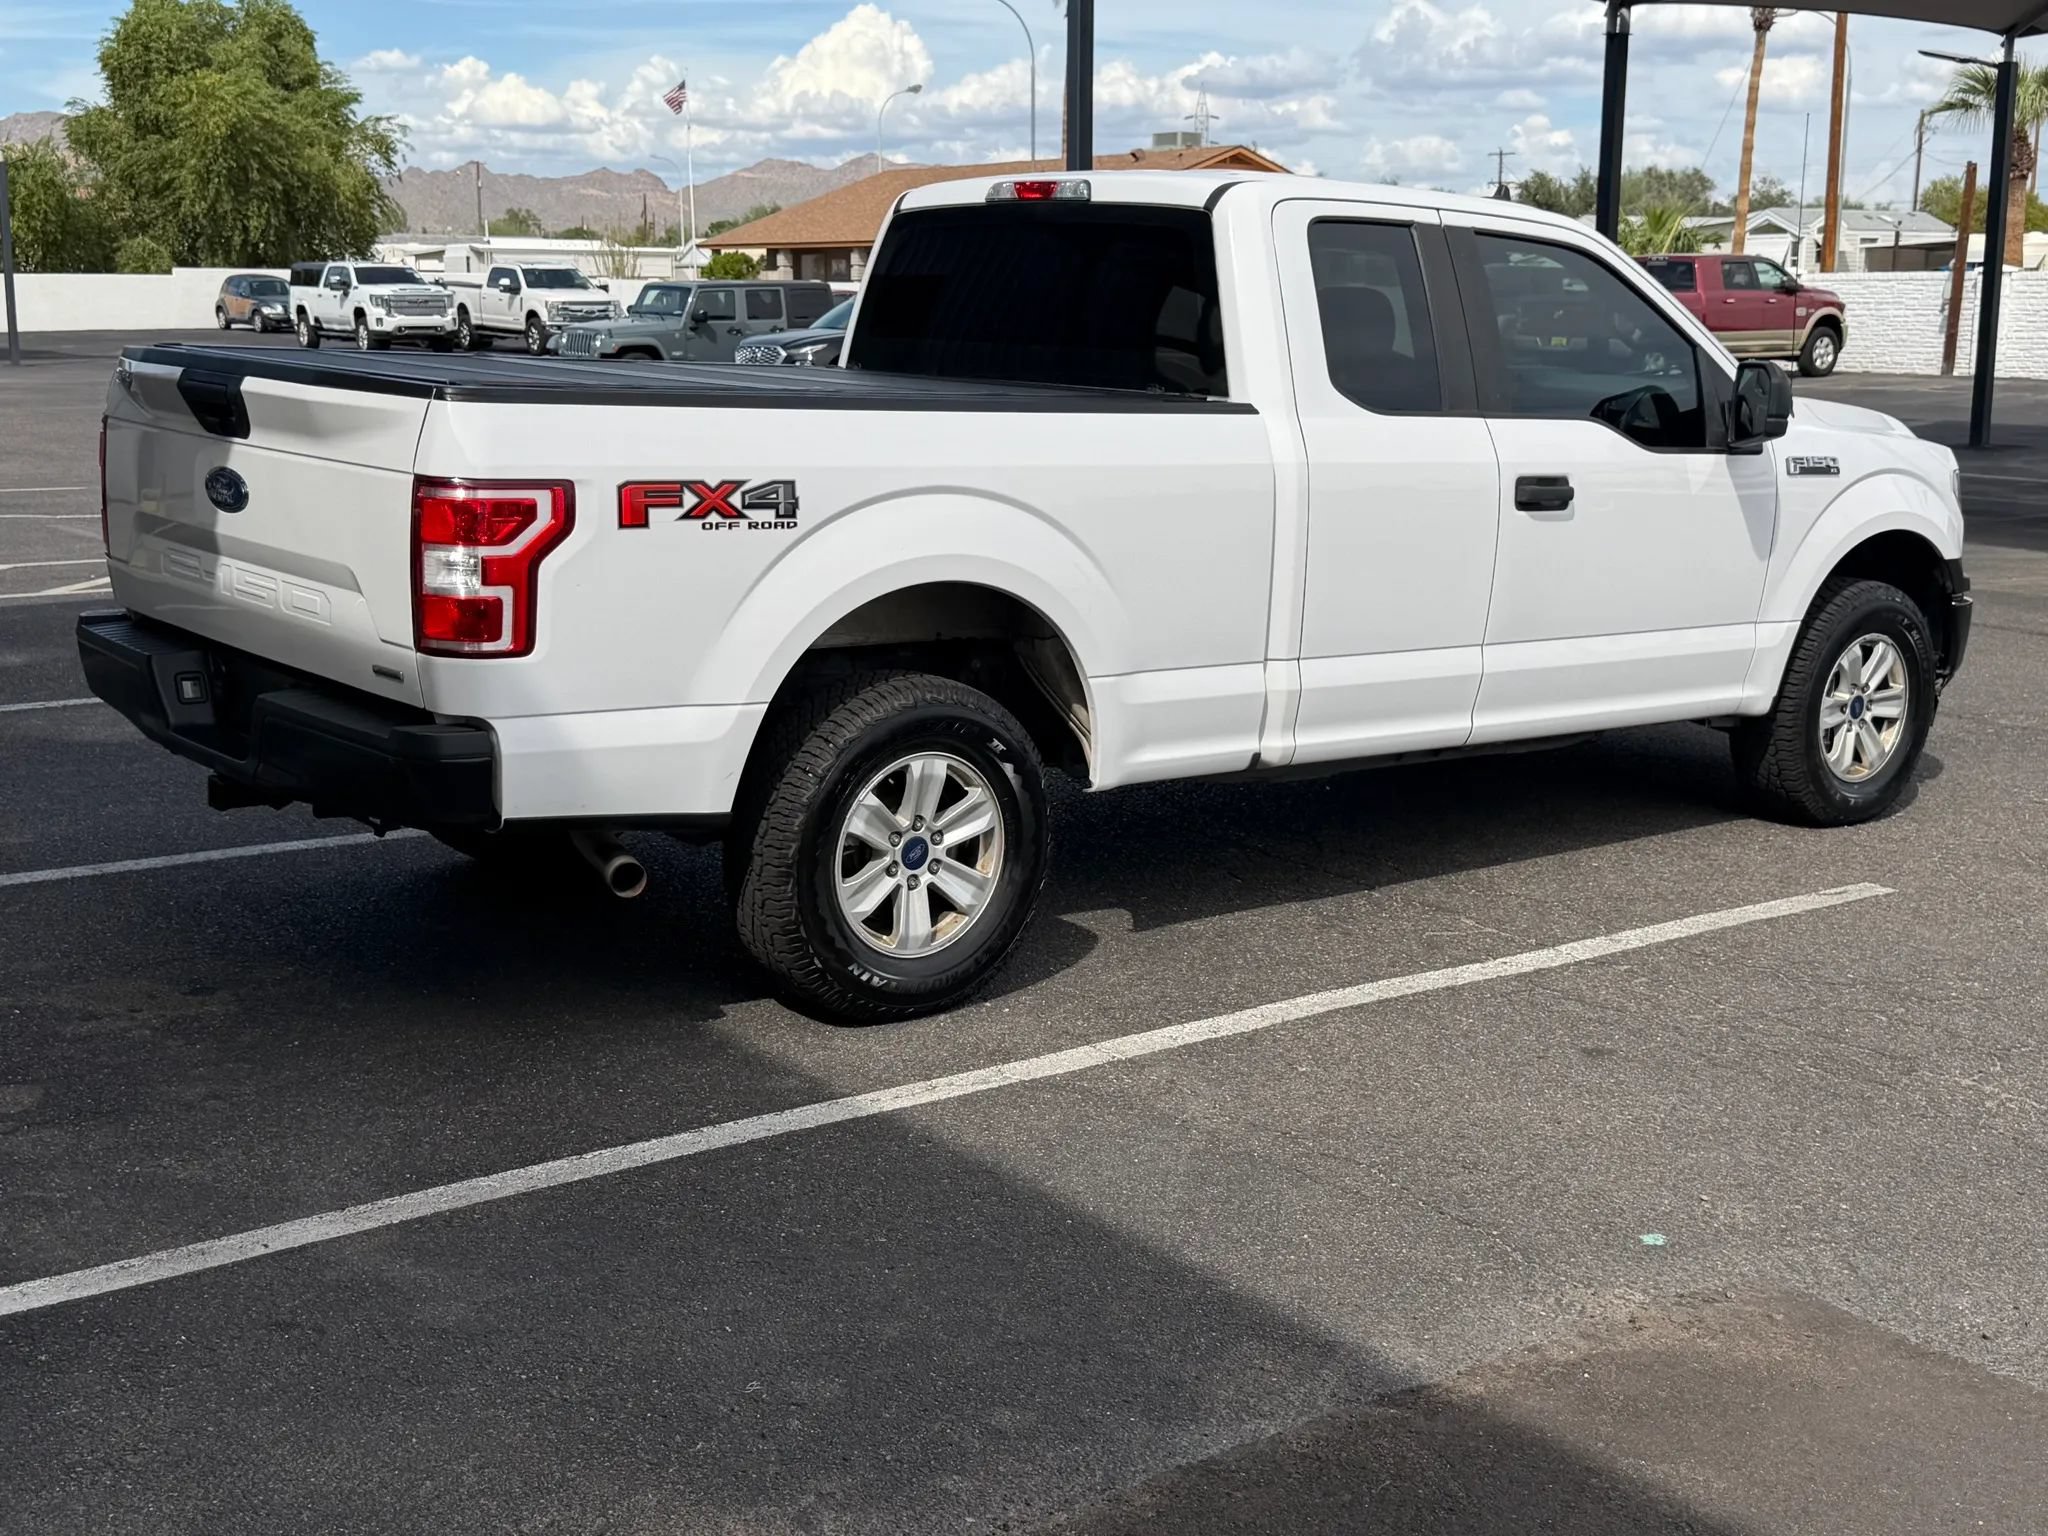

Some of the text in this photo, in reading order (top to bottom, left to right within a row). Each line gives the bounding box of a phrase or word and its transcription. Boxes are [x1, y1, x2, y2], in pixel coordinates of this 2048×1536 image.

[616, 479, 799, 530] FX4
[701, 521, 798, 530] OFF ROAD
